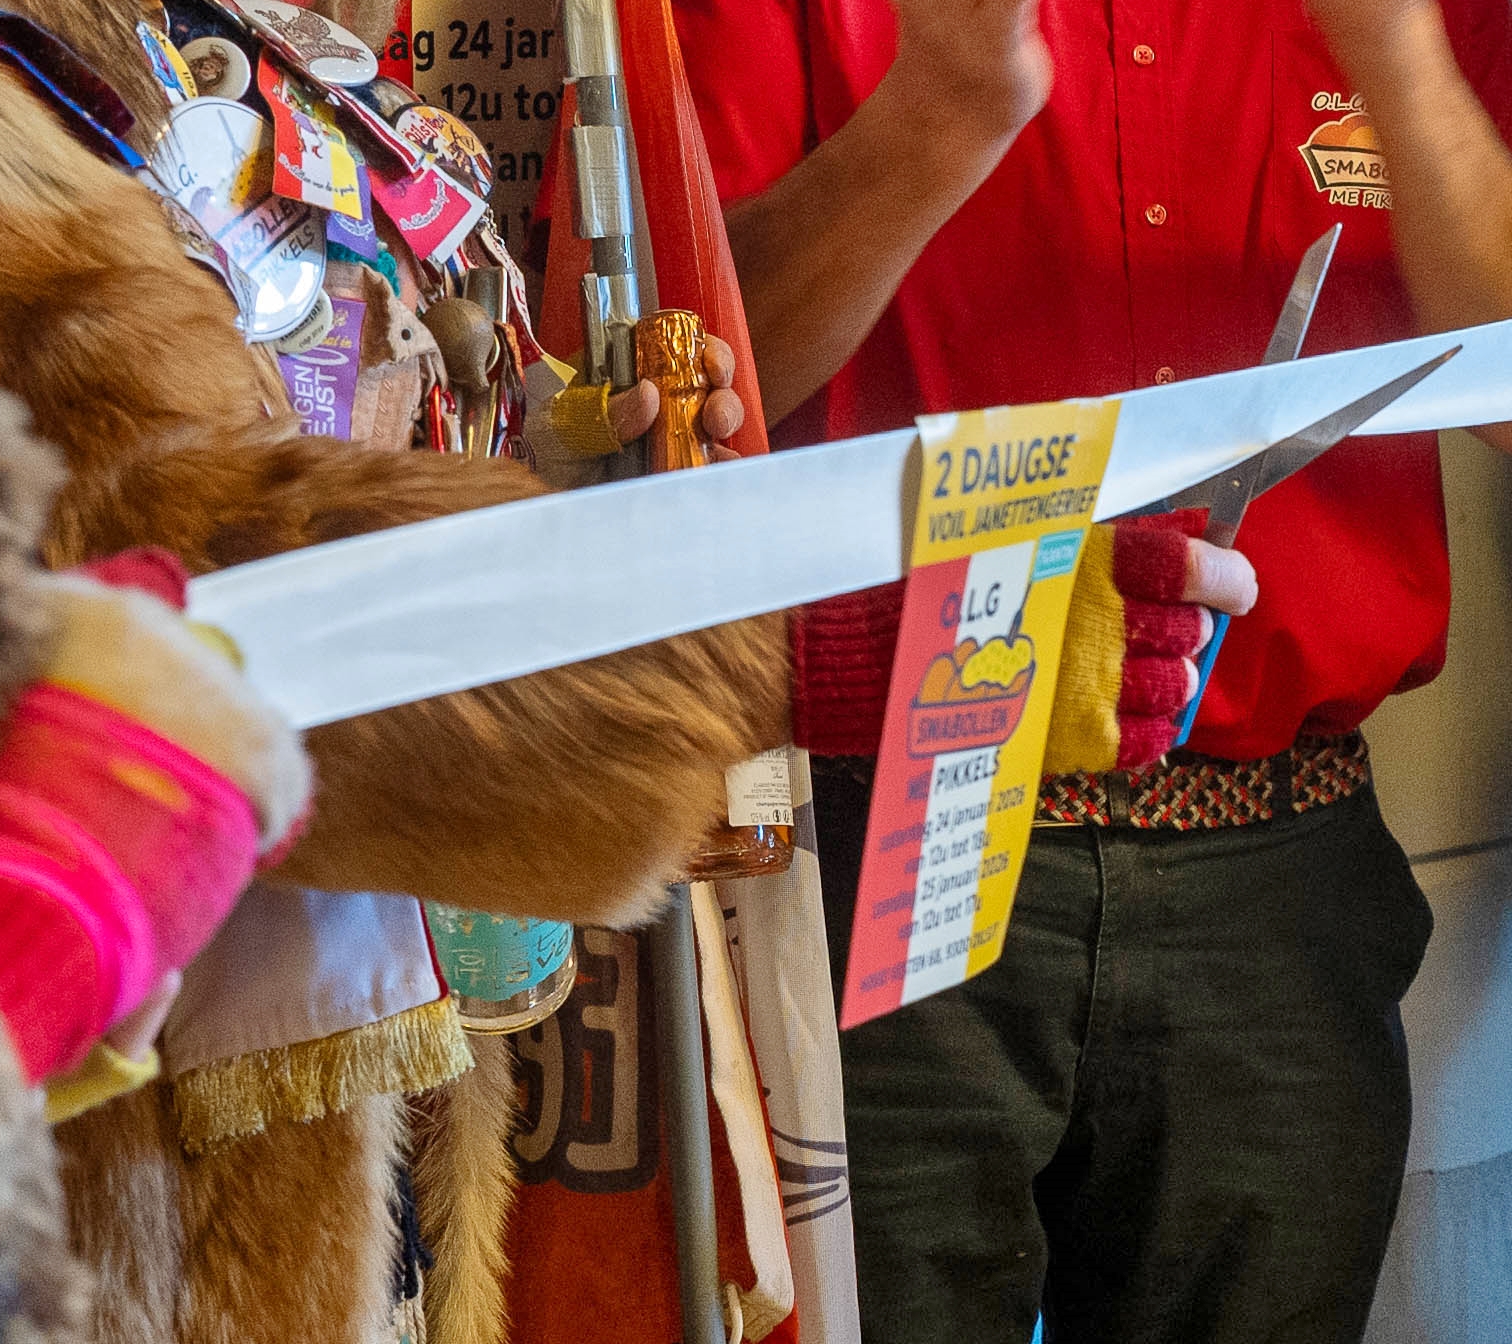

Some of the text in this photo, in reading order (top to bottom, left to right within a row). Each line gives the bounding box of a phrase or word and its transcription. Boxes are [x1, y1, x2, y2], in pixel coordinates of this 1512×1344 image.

[446, 19, 494, 58] 24
[440, 92, 504, 123] 12u
[1329, 189, 1359, 206] ME
[933, 432, 1078, 498] 2 DAUGSE
